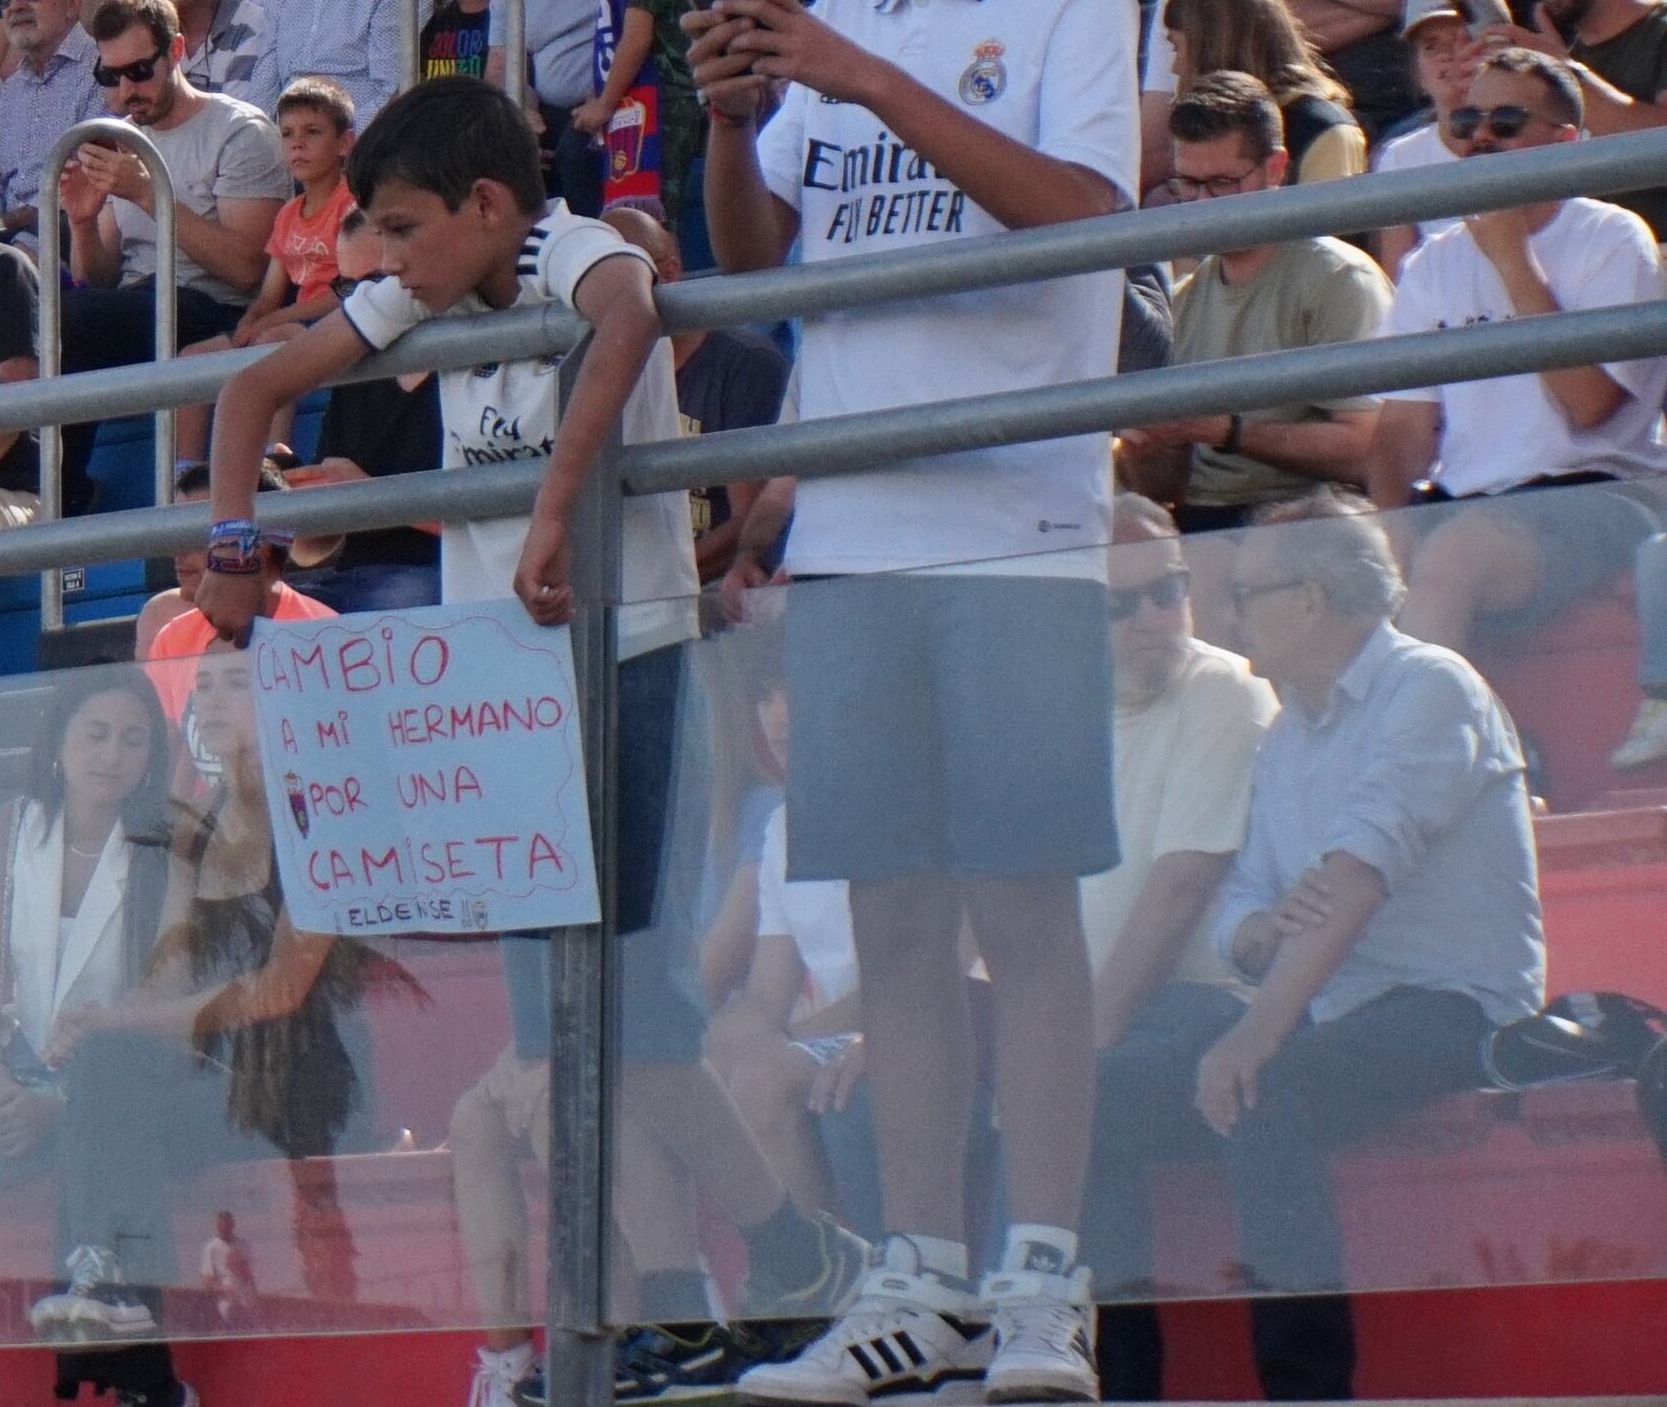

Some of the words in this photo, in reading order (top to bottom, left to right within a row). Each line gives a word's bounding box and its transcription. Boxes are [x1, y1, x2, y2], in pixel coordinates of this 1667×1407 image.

[804, 131, 948, 192] Emira
[866, 189, 966, 236] BETTER
[281, 718, 298, 754] A
[388, 696, 563, 746] HERMANO
[309, 777, 368, 817] POR
[396, 766, 483, 808] UNA
